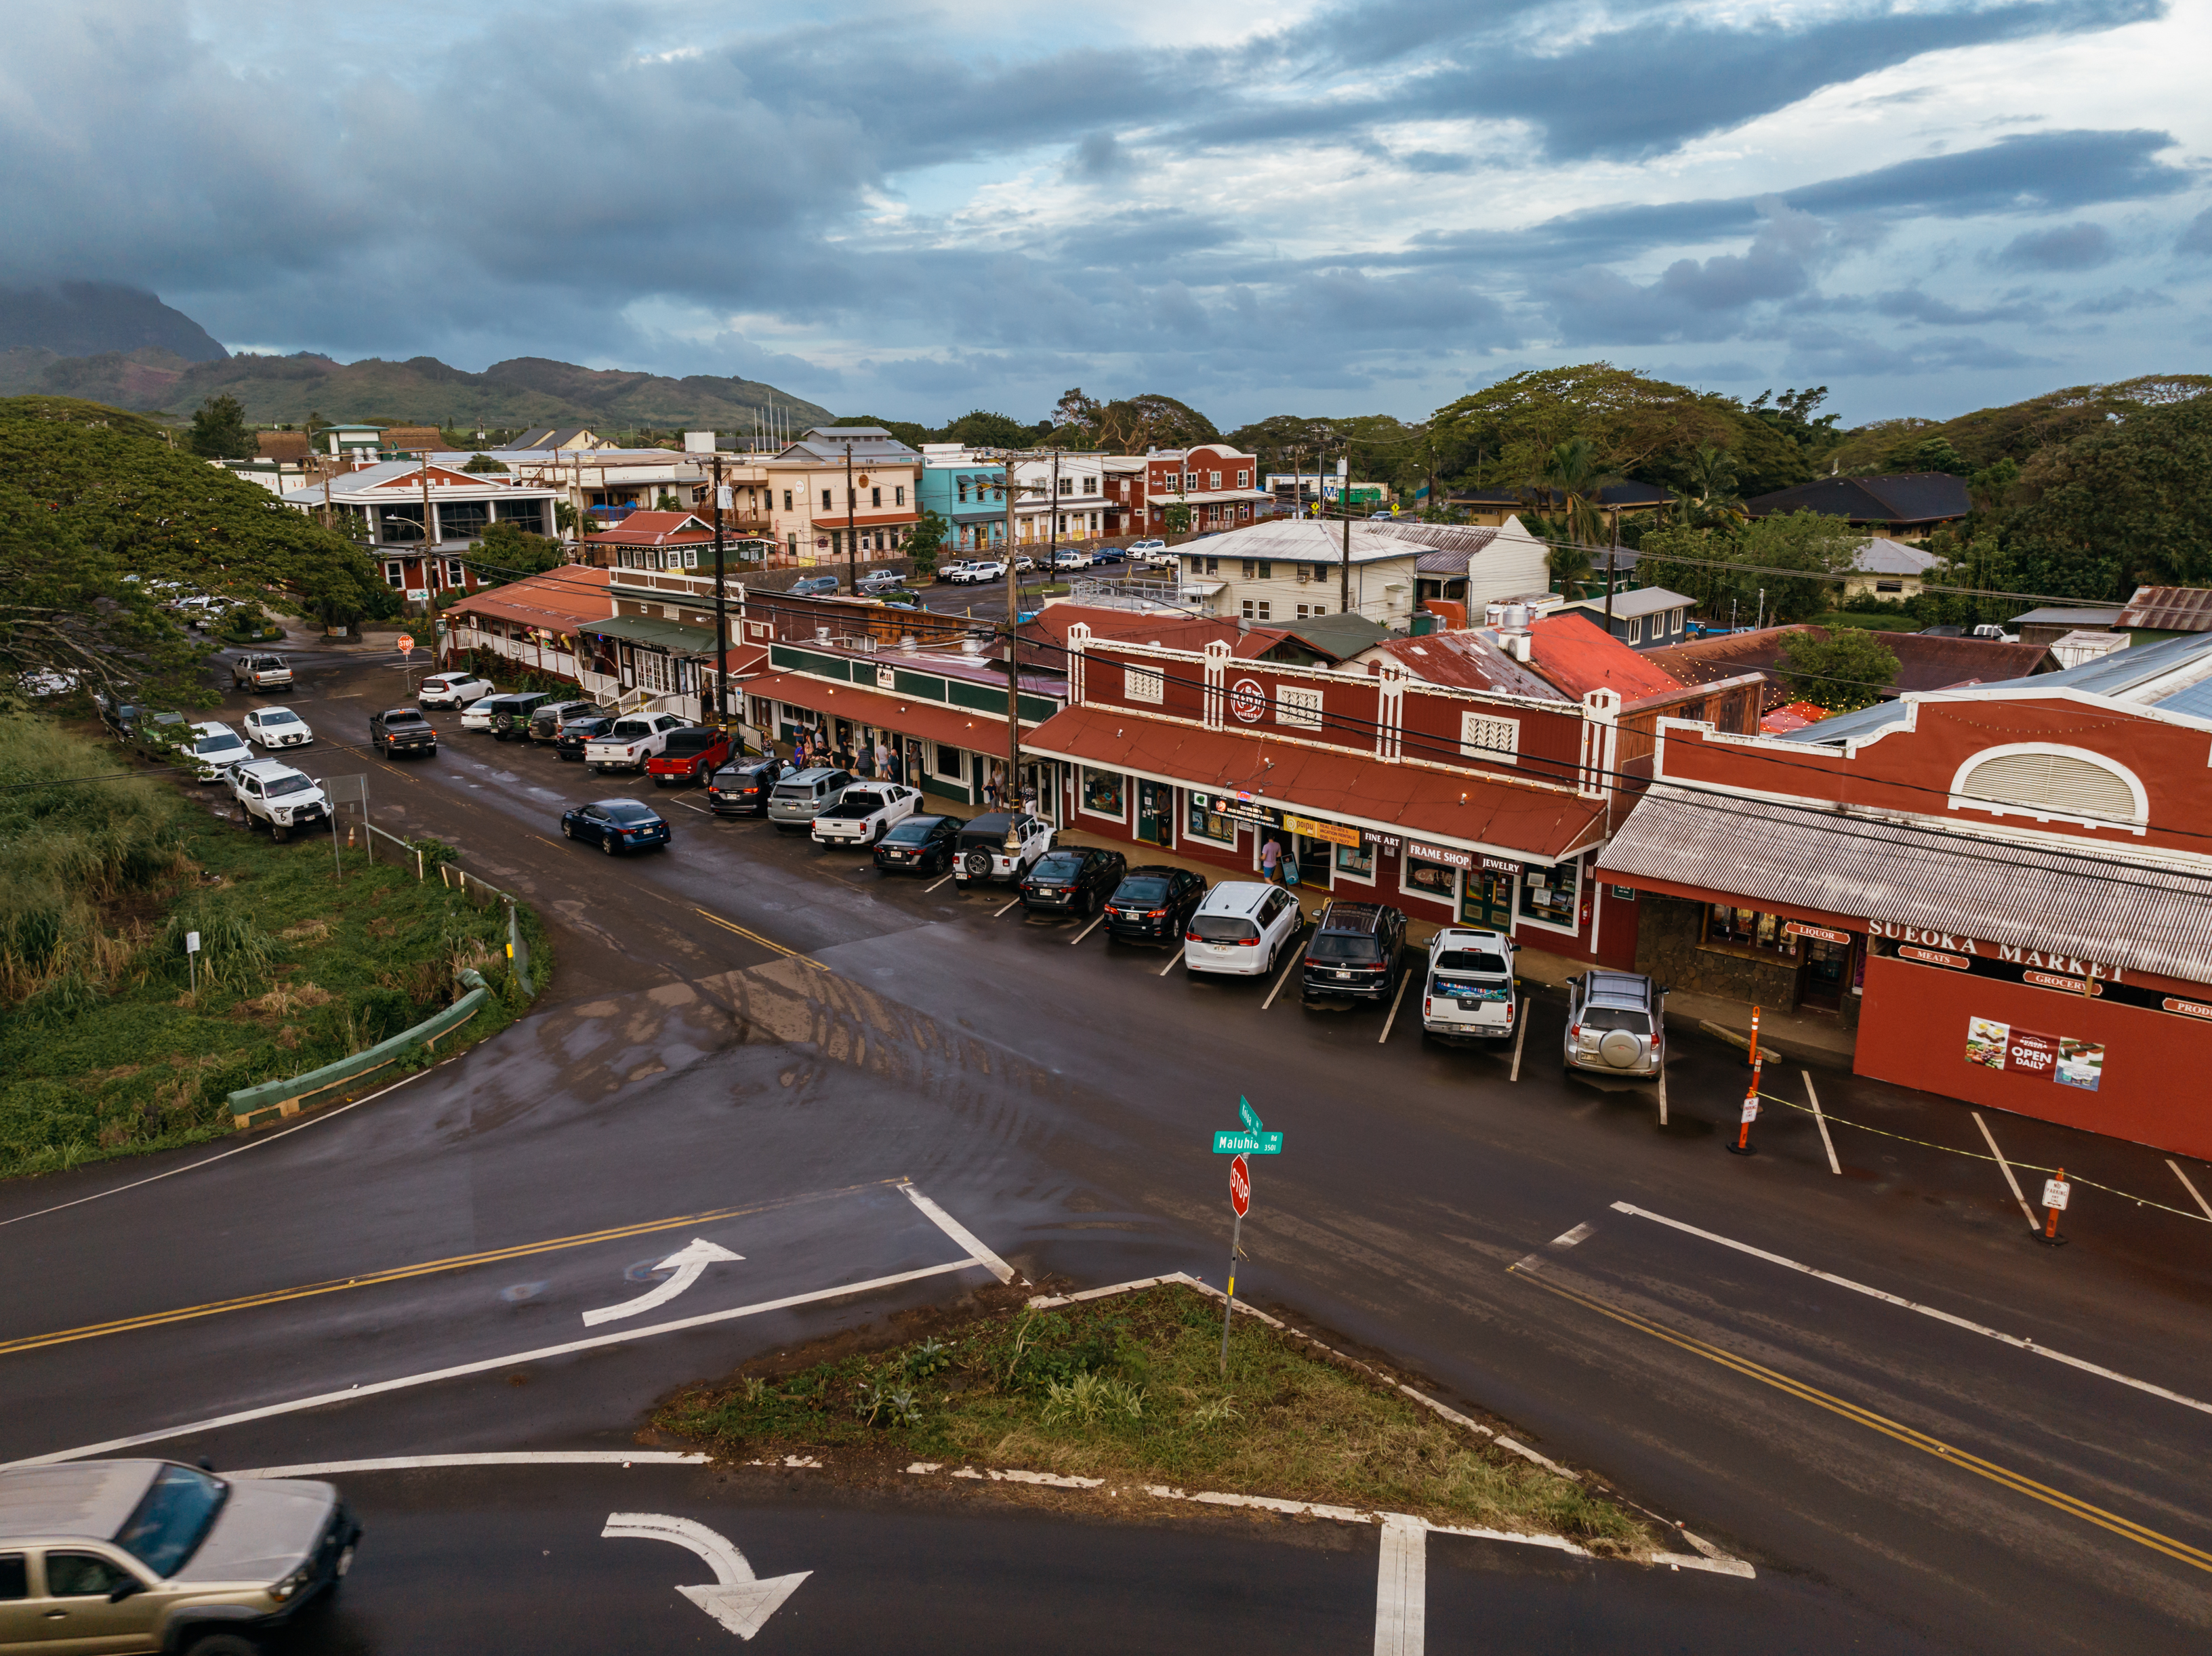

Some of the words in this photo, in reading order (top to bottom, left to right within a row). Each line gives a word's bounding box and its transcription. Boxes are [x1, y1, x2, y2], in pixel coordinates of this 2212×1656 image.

[1297, 821, 1313, 831] poipu
[1338, 832, 1355, 840] RENTALS
[1365, 832, 1381, 843] FINE
[1383, 836, 1399, 846] ART
[1410, 844, 1441, 860] FRAME
[1443, 852, 1469, 866] SHOP
[1483, 858, 1519, 873] JEWELRY
[1800, 926, 1835, 940] LIQUOR
[1868, 919, 1978, 954] SUEOKA
[1997, 944, 2128, 982] MARKET
[1917, 951, 1950, 964] MEATS
[2036, 974, 2087, 991] GROCERY
[2020, 1039, 2047, 1048] SUEOKA
[2011, 1046, 2052, 1064] OPEN
[2015, 1057, 2045, 1070] DAILY
[1231, 1167, 1248, 1203] STOP
[2047, 1188, 2066, 1197] PARKING
